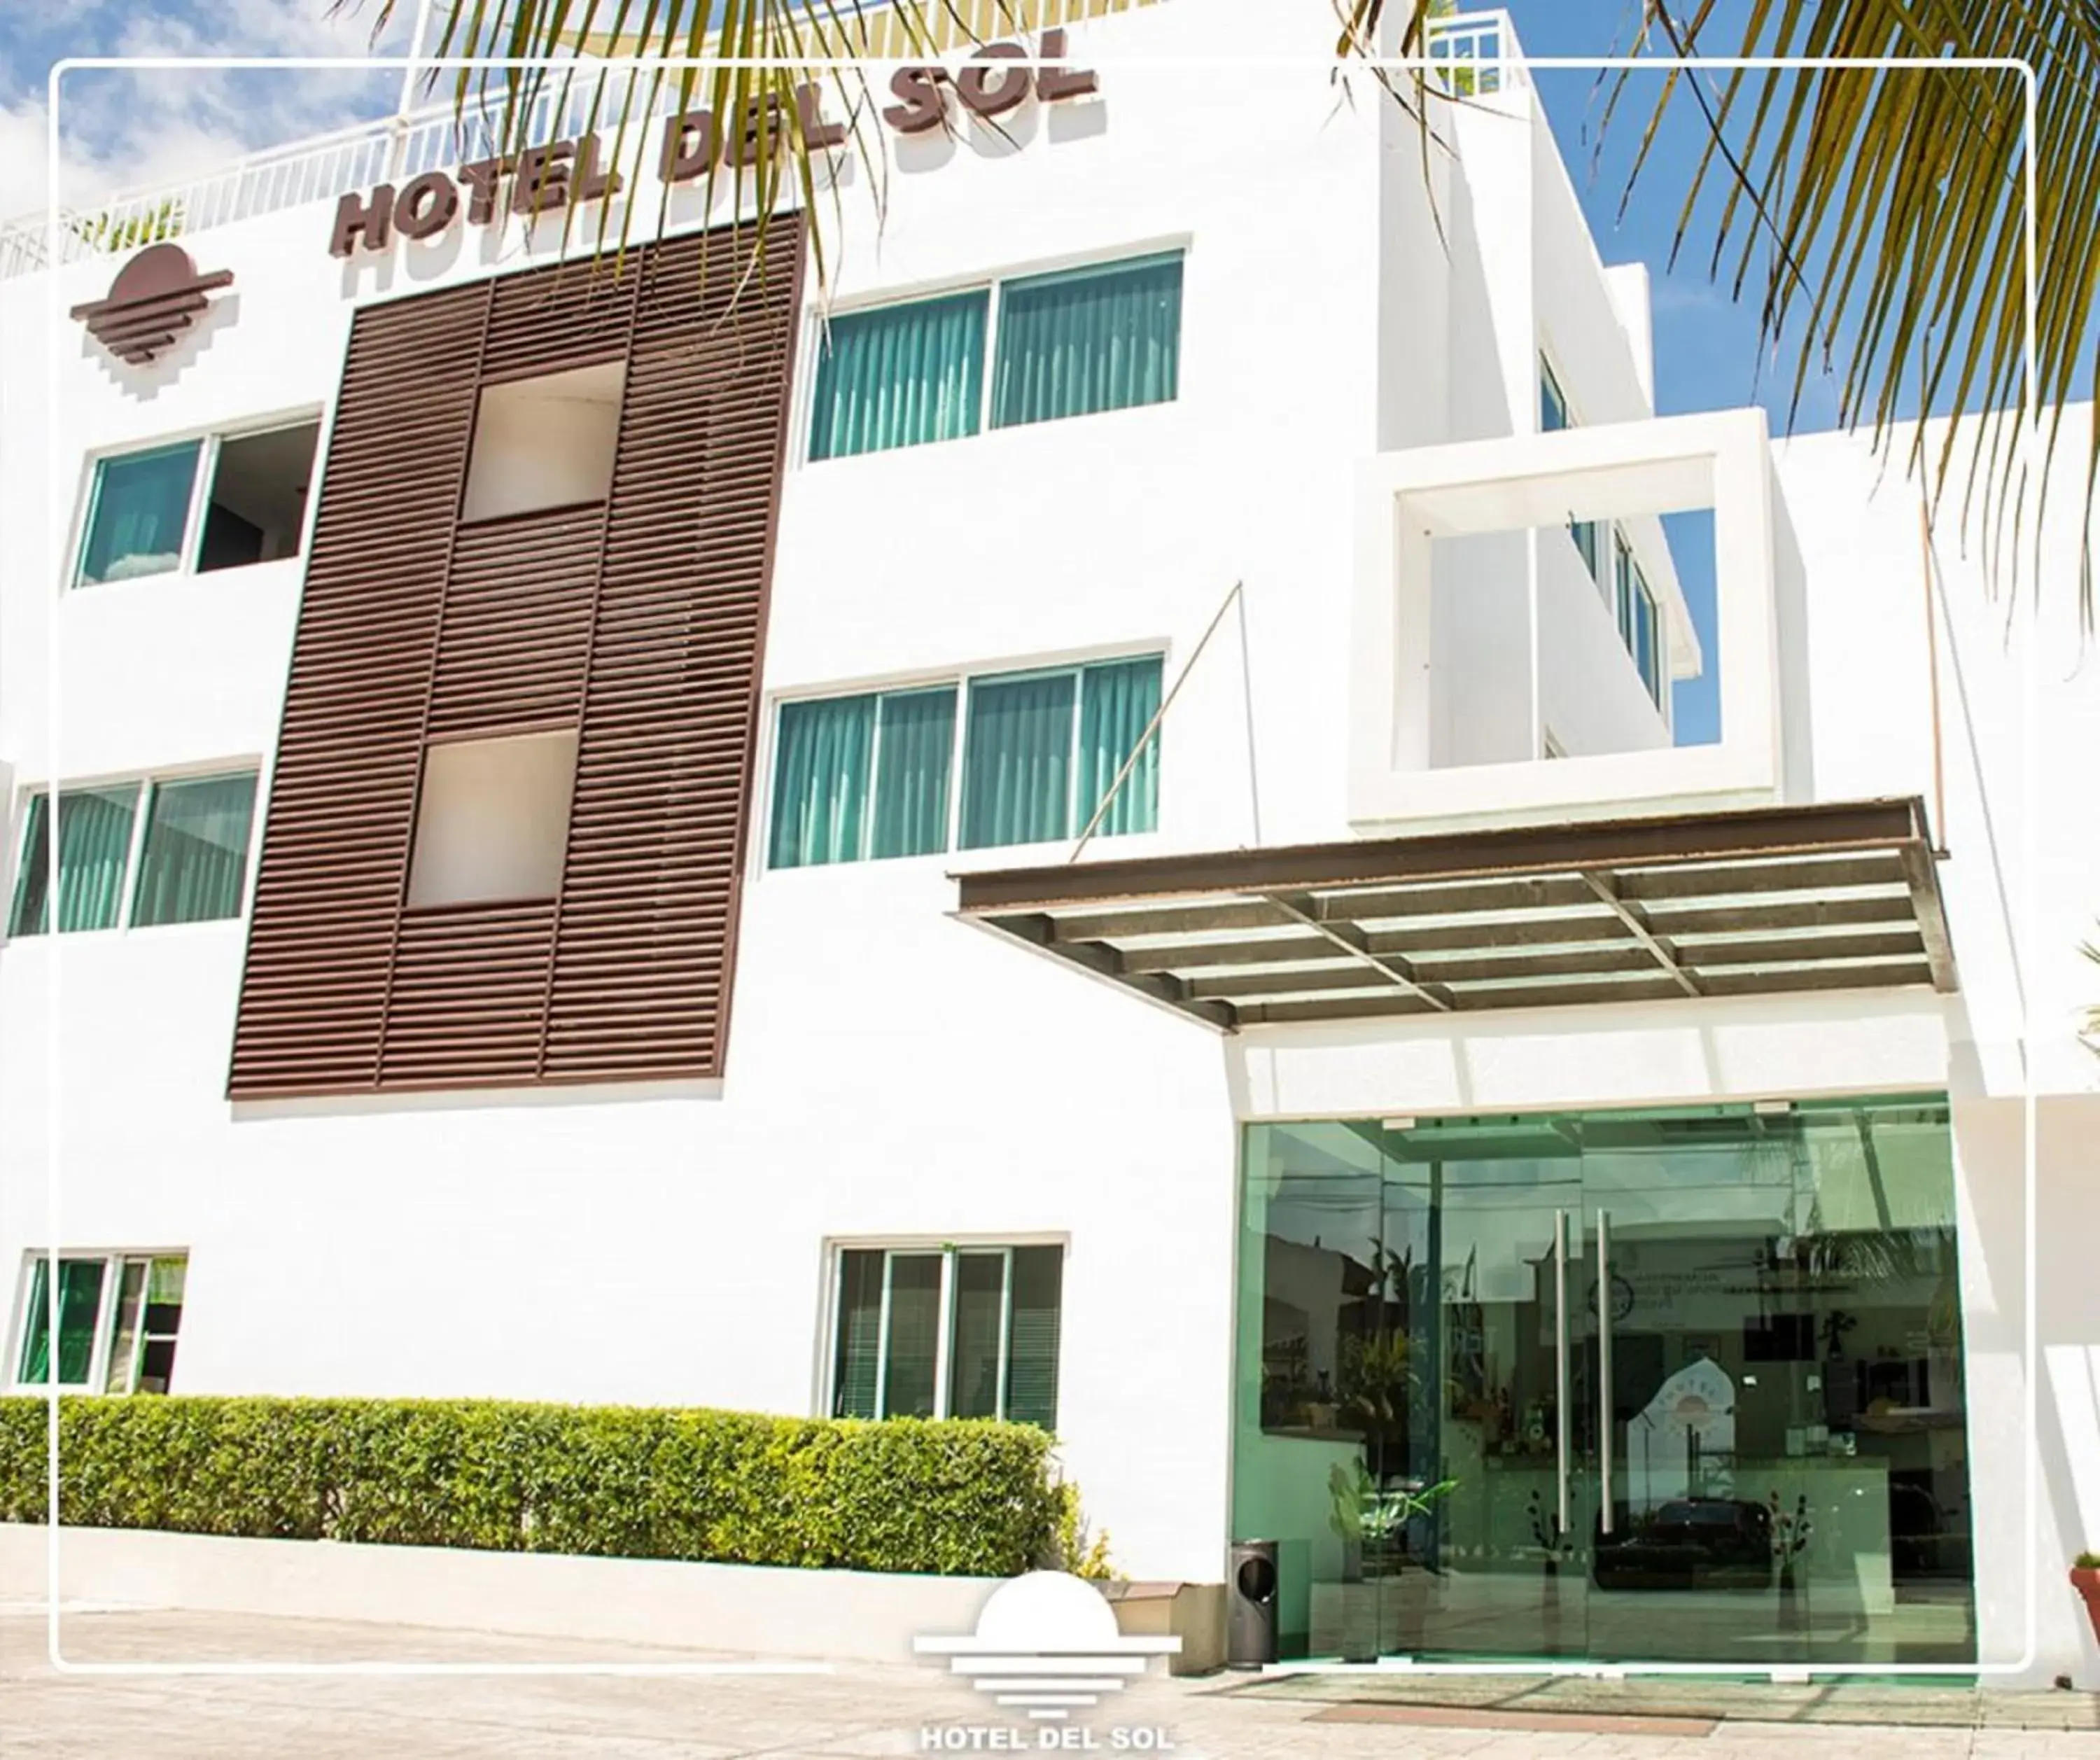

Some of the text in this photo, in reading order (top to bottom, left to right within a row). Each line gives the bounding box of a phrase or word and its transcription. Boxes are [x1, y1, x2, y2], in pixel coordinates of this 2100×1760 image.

[328, 27, 1099, 258] HOTEL DEL SOL
